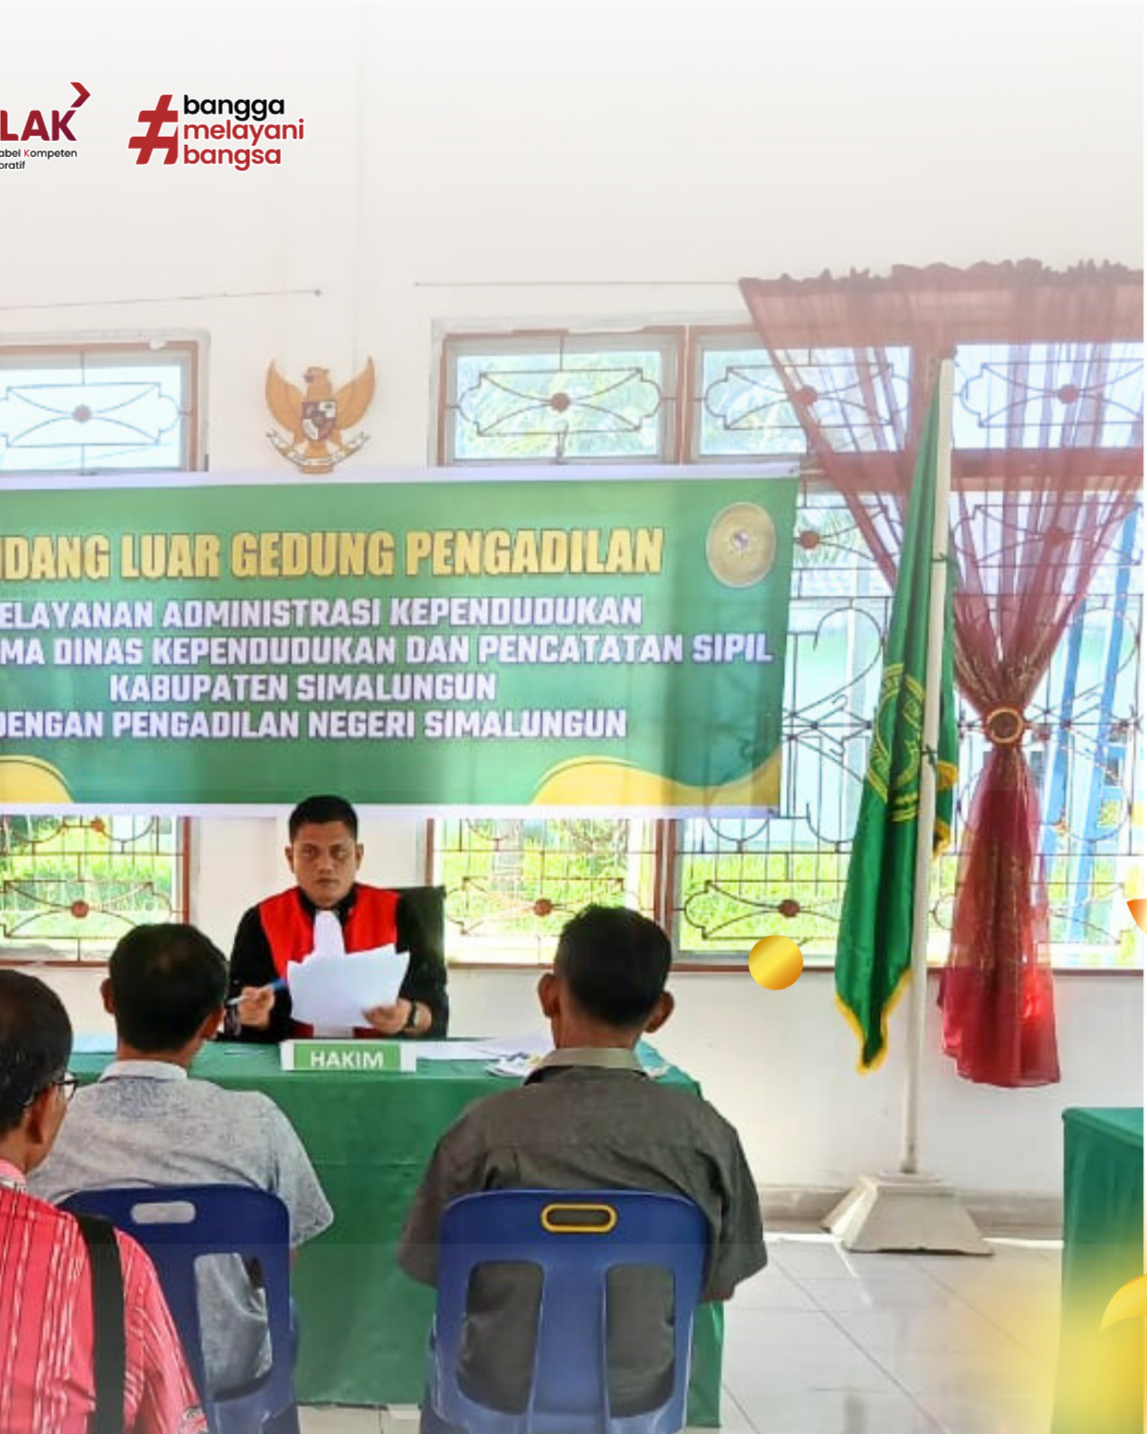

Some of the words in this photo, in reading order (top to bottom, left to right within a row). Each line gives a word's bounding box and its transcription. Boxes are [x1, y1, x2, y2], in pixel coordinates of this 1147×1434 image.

[121, 533, 221, 579] LUAR
[231, 530, 396, 579] GEDUNG
[405, 527, 665, 577] PENGADILAN
[162, 597, 381, 629] ADMINISTRASI
[389, 596, 643, 626] KEPENDUDUKAN
[53, 637, 144, 665] DINAS
[152, 636, 396, 666] KEPENDUDUKAN
[406, 636, 469, 664] DAN
[478, 634, 683, 663] PENCATATAN
[692, 633, 773, 663] SIPIL
[109, 674, 289, 702] KABUPATEN
[296, 673, 497, 701] SIMALUNGUN
[112, 710, 300, 738] PENGADILAN
[308, 710, 415, 739] NEGERI
[423, 709, 628, 738] SIMALUNGUN
[310, 1051, 385, 1069] HAKIM
